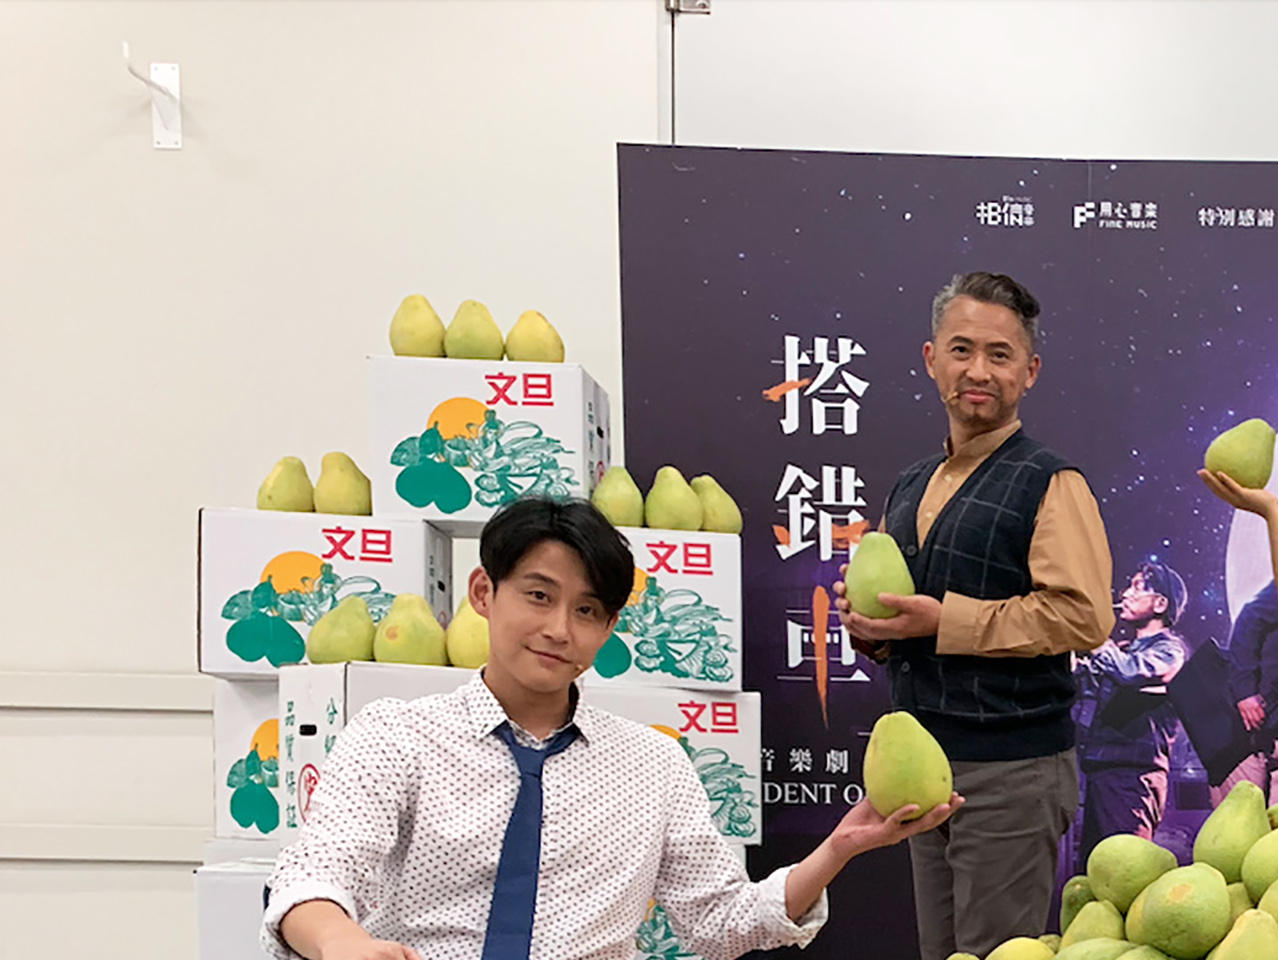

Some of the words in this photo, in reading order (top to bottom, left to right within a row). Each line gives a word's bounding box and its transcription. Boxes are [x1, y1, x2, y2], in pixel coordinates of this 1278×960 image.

[1126, 219, 1158, 230] MUSIC
[1198, 207, 1275, 228] 特別感謝
[485, 373, 554, 407] 文旦
[321, 527, 393, 563] 文旦
[646, 541, 714, 576] 文旦
[677, 701, 739, 734] 文旦
